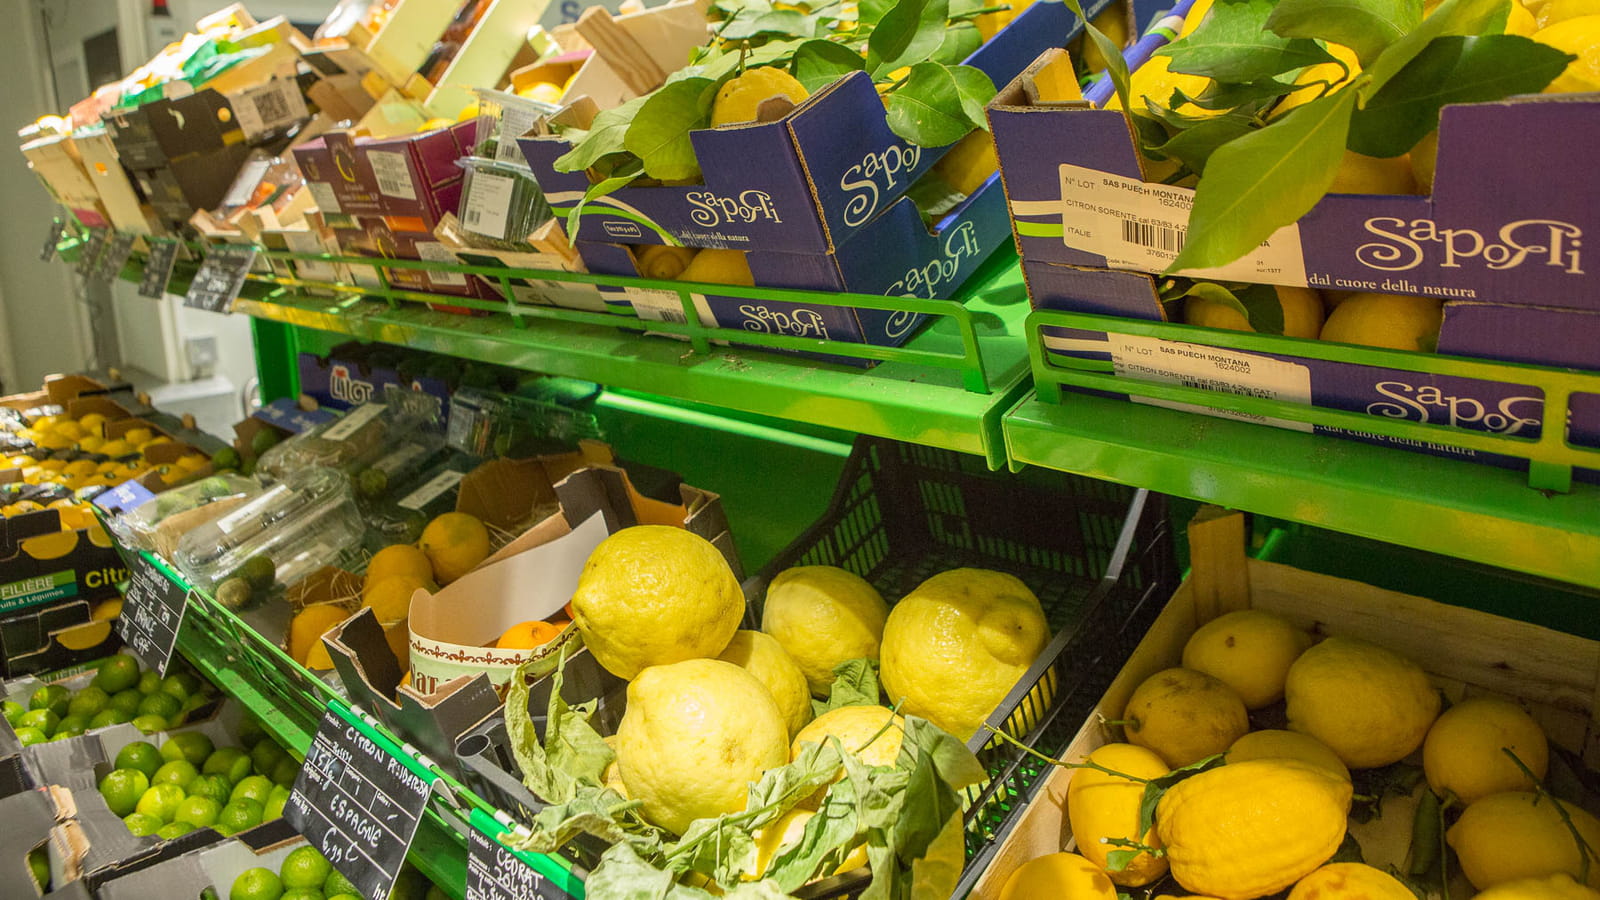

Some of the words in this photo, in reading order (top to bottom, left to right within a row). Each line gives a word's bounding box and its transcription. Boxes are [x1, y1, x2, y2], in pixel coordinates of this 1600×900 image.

[1077, 179, 1096, 190] LOT
[1103, 178, 1119, 189] SAS
[1121, 182, 1151, 196] PUECH
[1066, 199, 1096, 213] CITRON
[1098, 206, 1137, 221] SORENTE
[1067, 226, 1092, 238] ITALIE
[1335, 277, 1377, 291] cuore
[1381, 279, 1418, 294] della
[1423, 285, 1477, 299] natura
[1136, 346, 1153, 356] LOT
[1159, 346, 1176, 355] SAS
[1177, 349, 1206, 360] PUECH
[1207, 354, 1250, 368] MONTANA
[1127, 363, 1157, 375] CITRON
[1158, 369, 1196, 382] SORENTE
[330, 794, 382, 848] ESPAGNE
